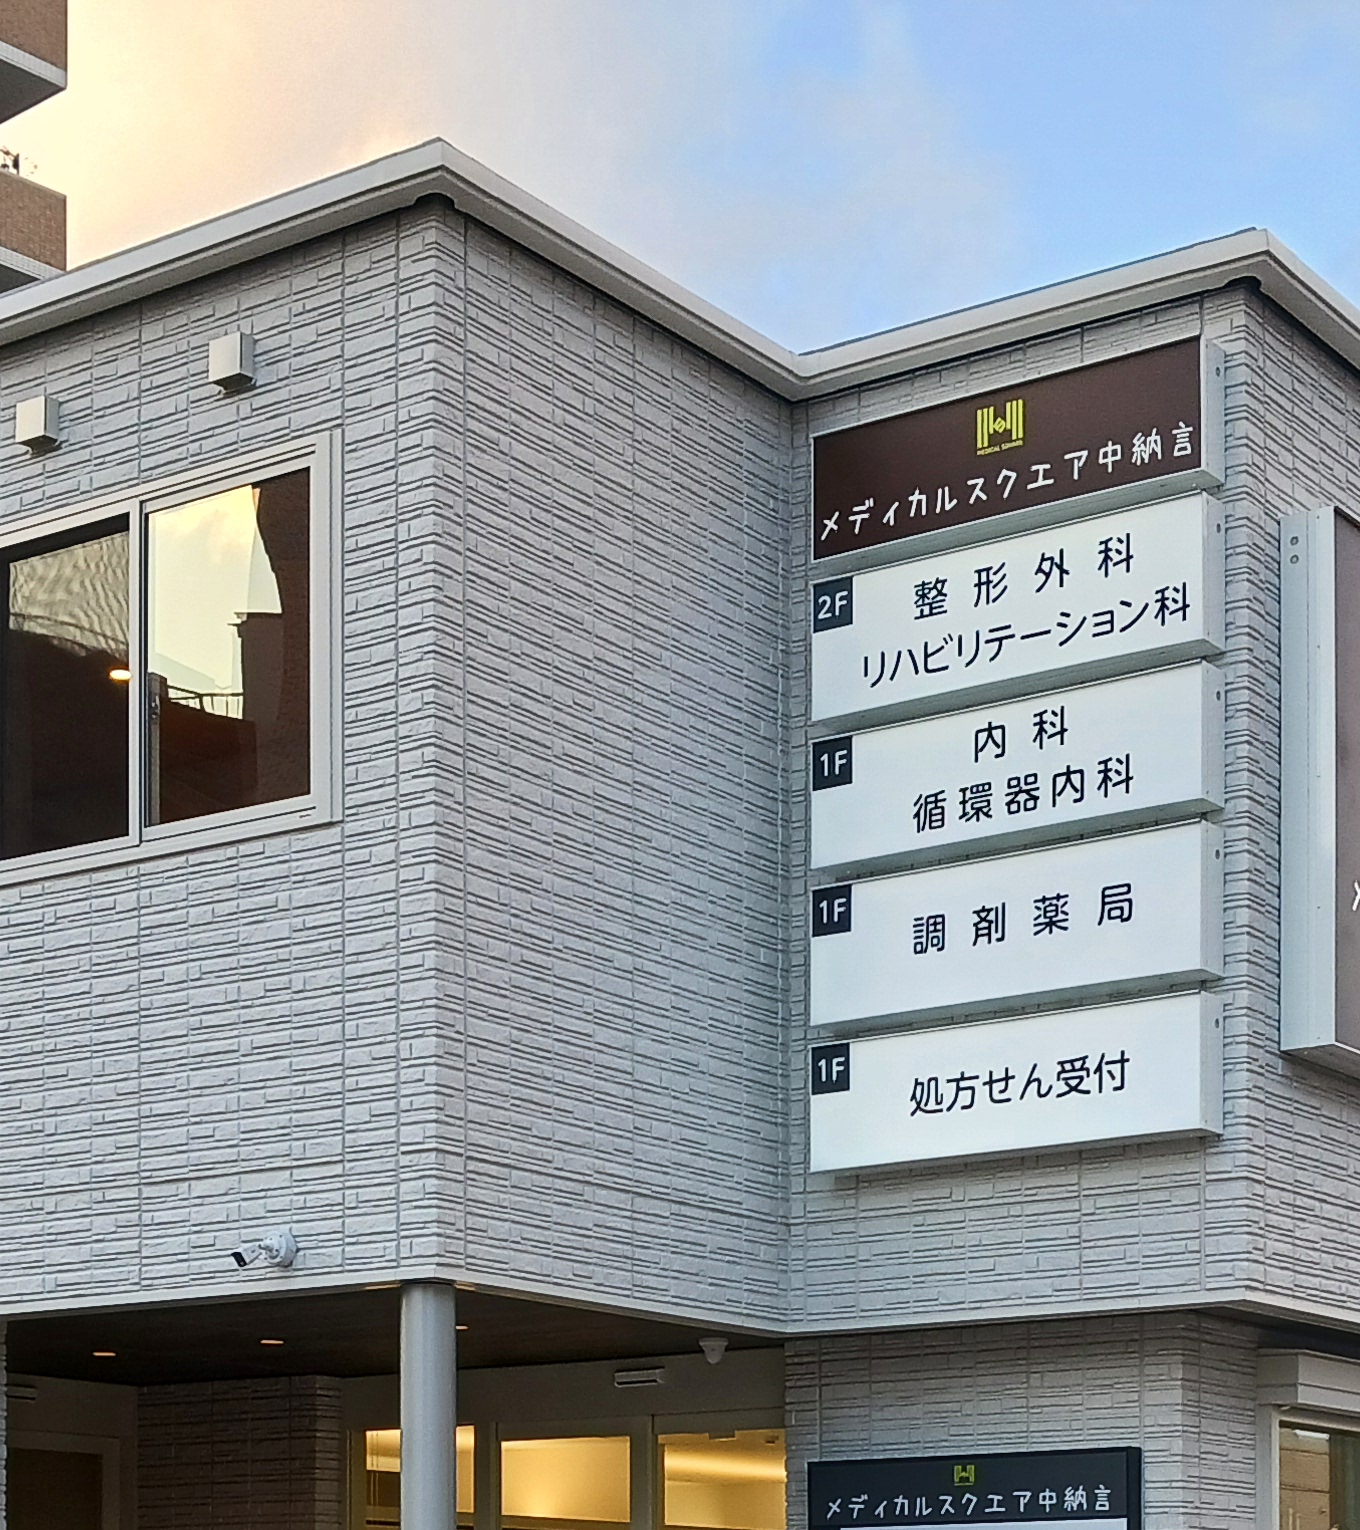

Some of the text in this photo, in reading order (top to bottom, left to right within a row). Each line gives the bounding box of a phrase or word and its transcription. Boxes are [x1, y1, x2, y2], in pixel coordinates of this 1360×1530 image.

[821, 422, 1194, 540] メディカルスクエア中納言
[818, 590, 849, 620] 2F
[914, 533, 1133, 620] 整形外科
[863, 582, 1190, 688] リハビリテーション科
[820, 748, 848, 777] 1F
[974, 706, 1068, 763] 内科
[913, 753, 1133, 833] 循環器内科
[819, 897, 847, 924] 1F
[912, 883, 1133, 955] 調剤薬局
[818, 1056, 846, 1083] 1F
[909, 1050, 1131, 1117] 処方せん受付
[826, 1484, 1112, 1519] メディカルスクエア中納言
